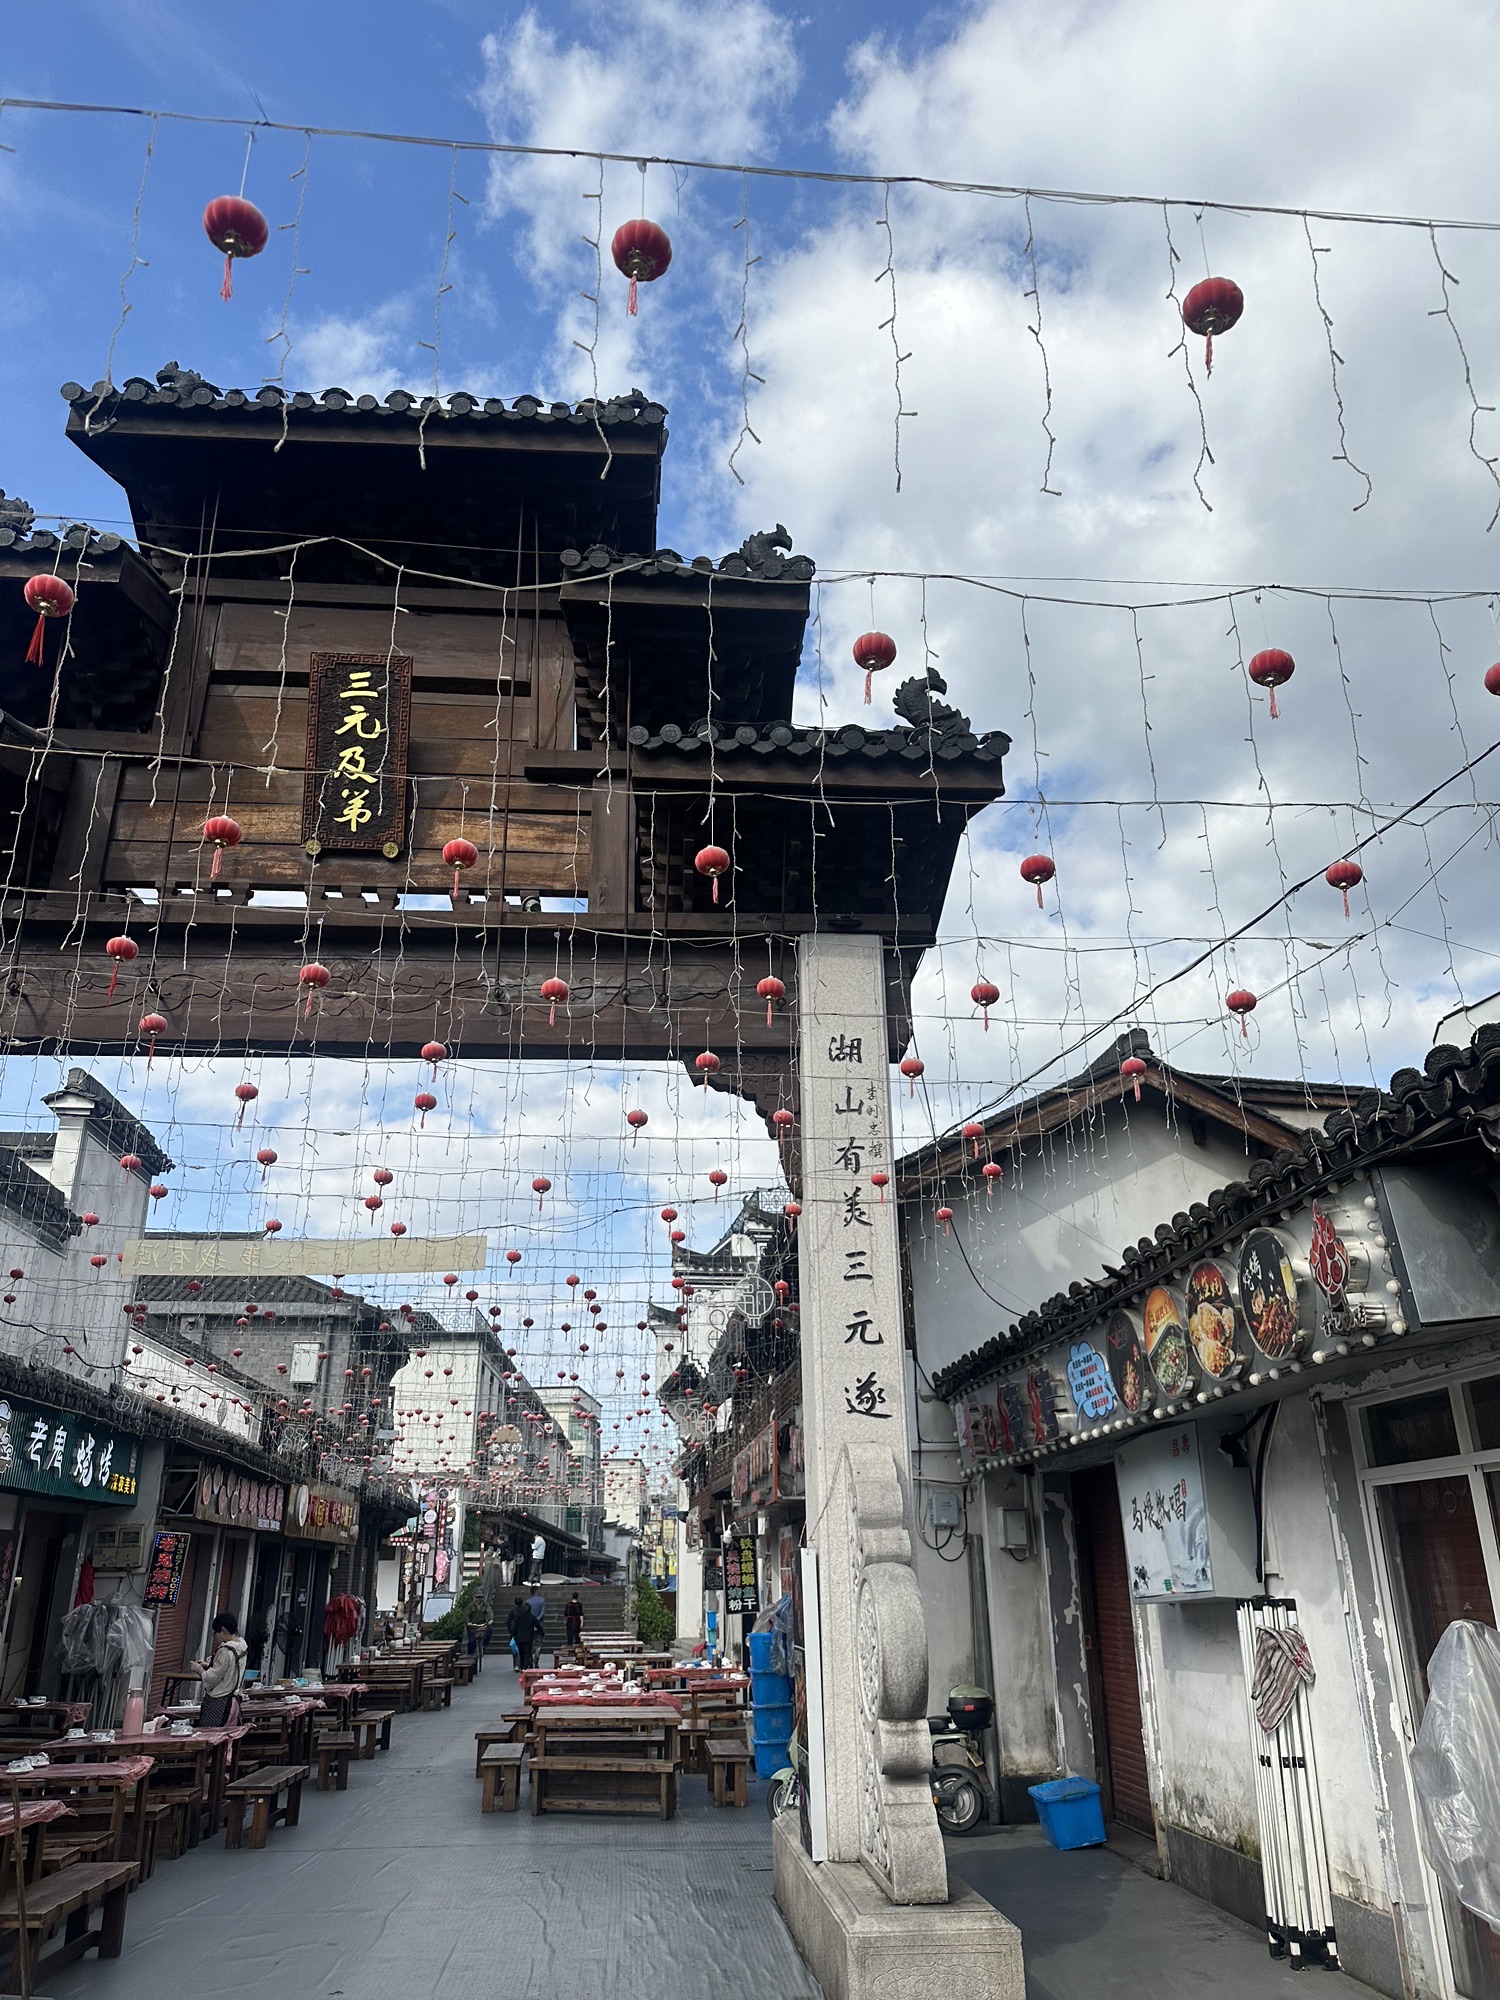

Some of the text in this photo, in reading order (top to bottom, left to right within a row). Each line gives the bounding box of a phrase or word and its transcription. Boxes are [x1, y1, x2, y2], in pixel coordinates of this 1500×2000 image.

[333, 670, 381, 833] 三元及第
[828, 1033, 893, 1420] 湖山有美三元遂
[728, 1598, 757, 1611] 粉干
